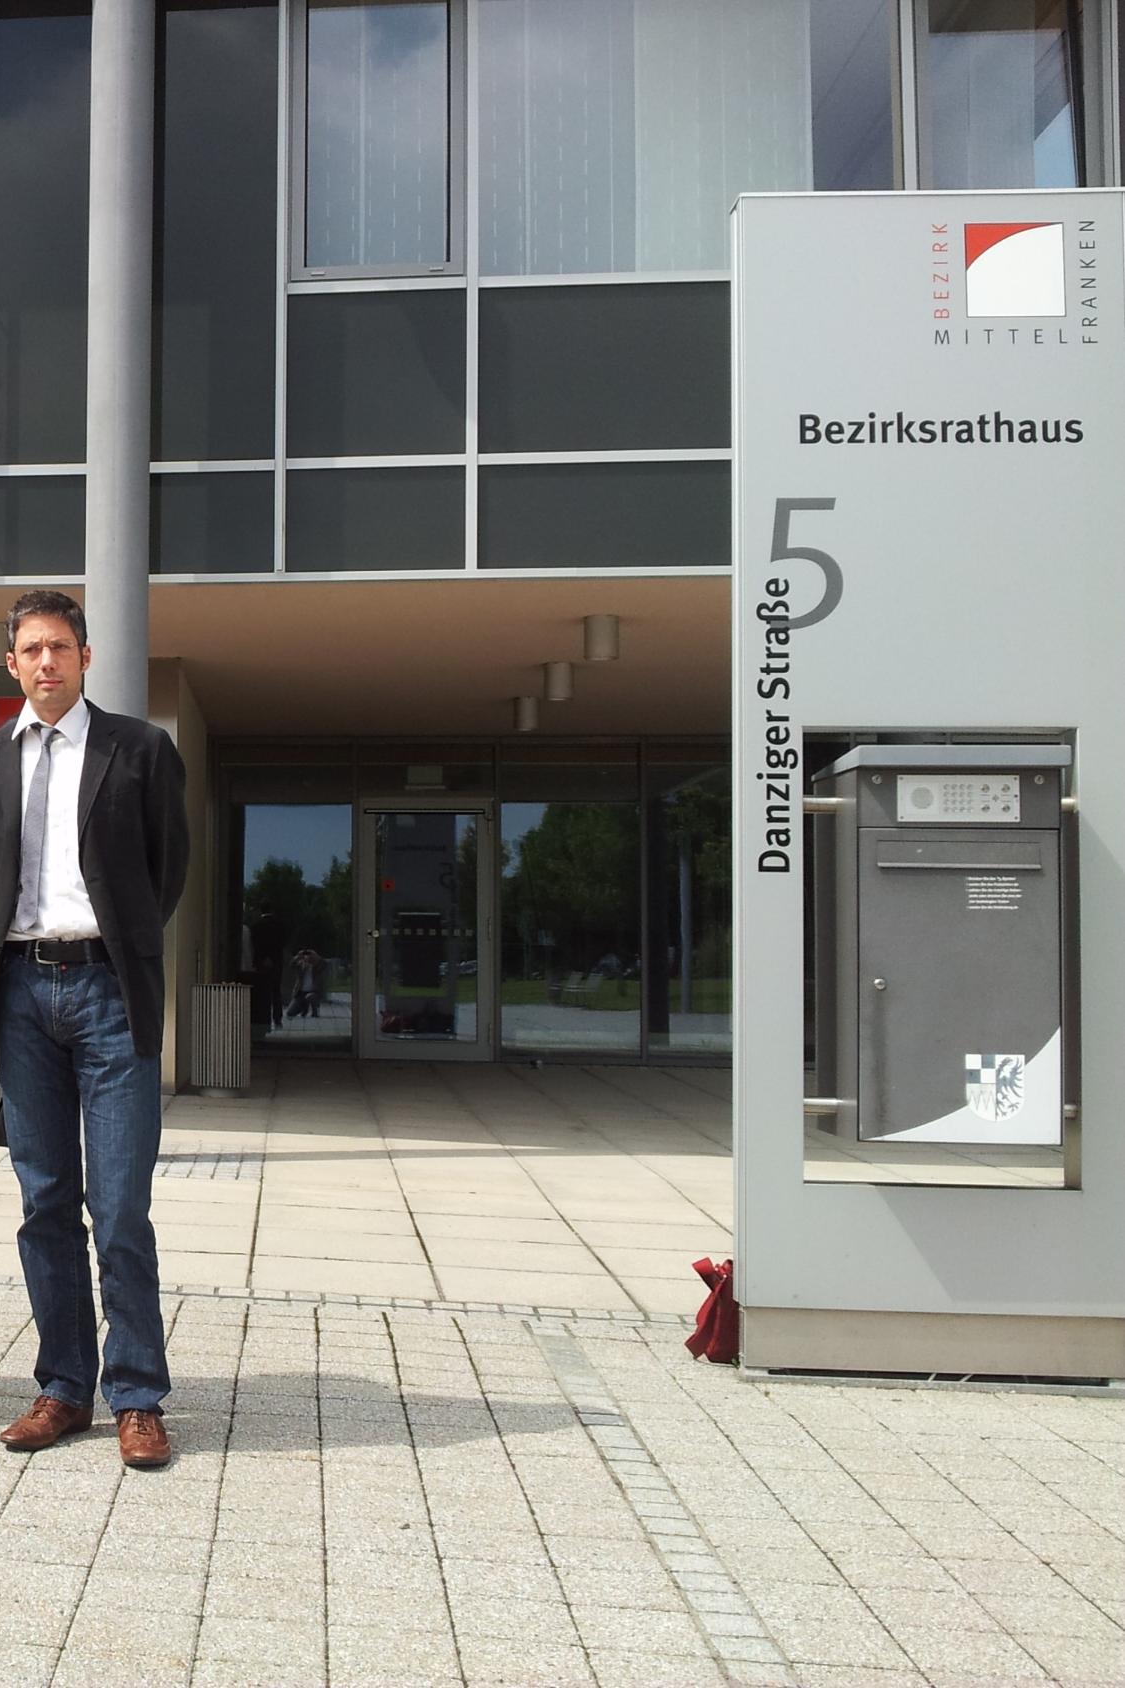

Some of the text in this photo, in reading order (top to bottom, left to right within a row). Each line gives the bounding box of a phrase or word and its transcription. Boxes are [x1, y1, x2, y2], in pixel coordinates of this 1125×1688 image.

[932, 223, 950, 319] BEZIRK
[1079, 220, 1098, 344] FRANKEN
[934, 328, 1068, 345] MITTEL
[799, 411, 1084, 444] Bezirksrathaus
[770, 497, 844, 630] 5
[757, 577, 798, 873] Danziger Straße
